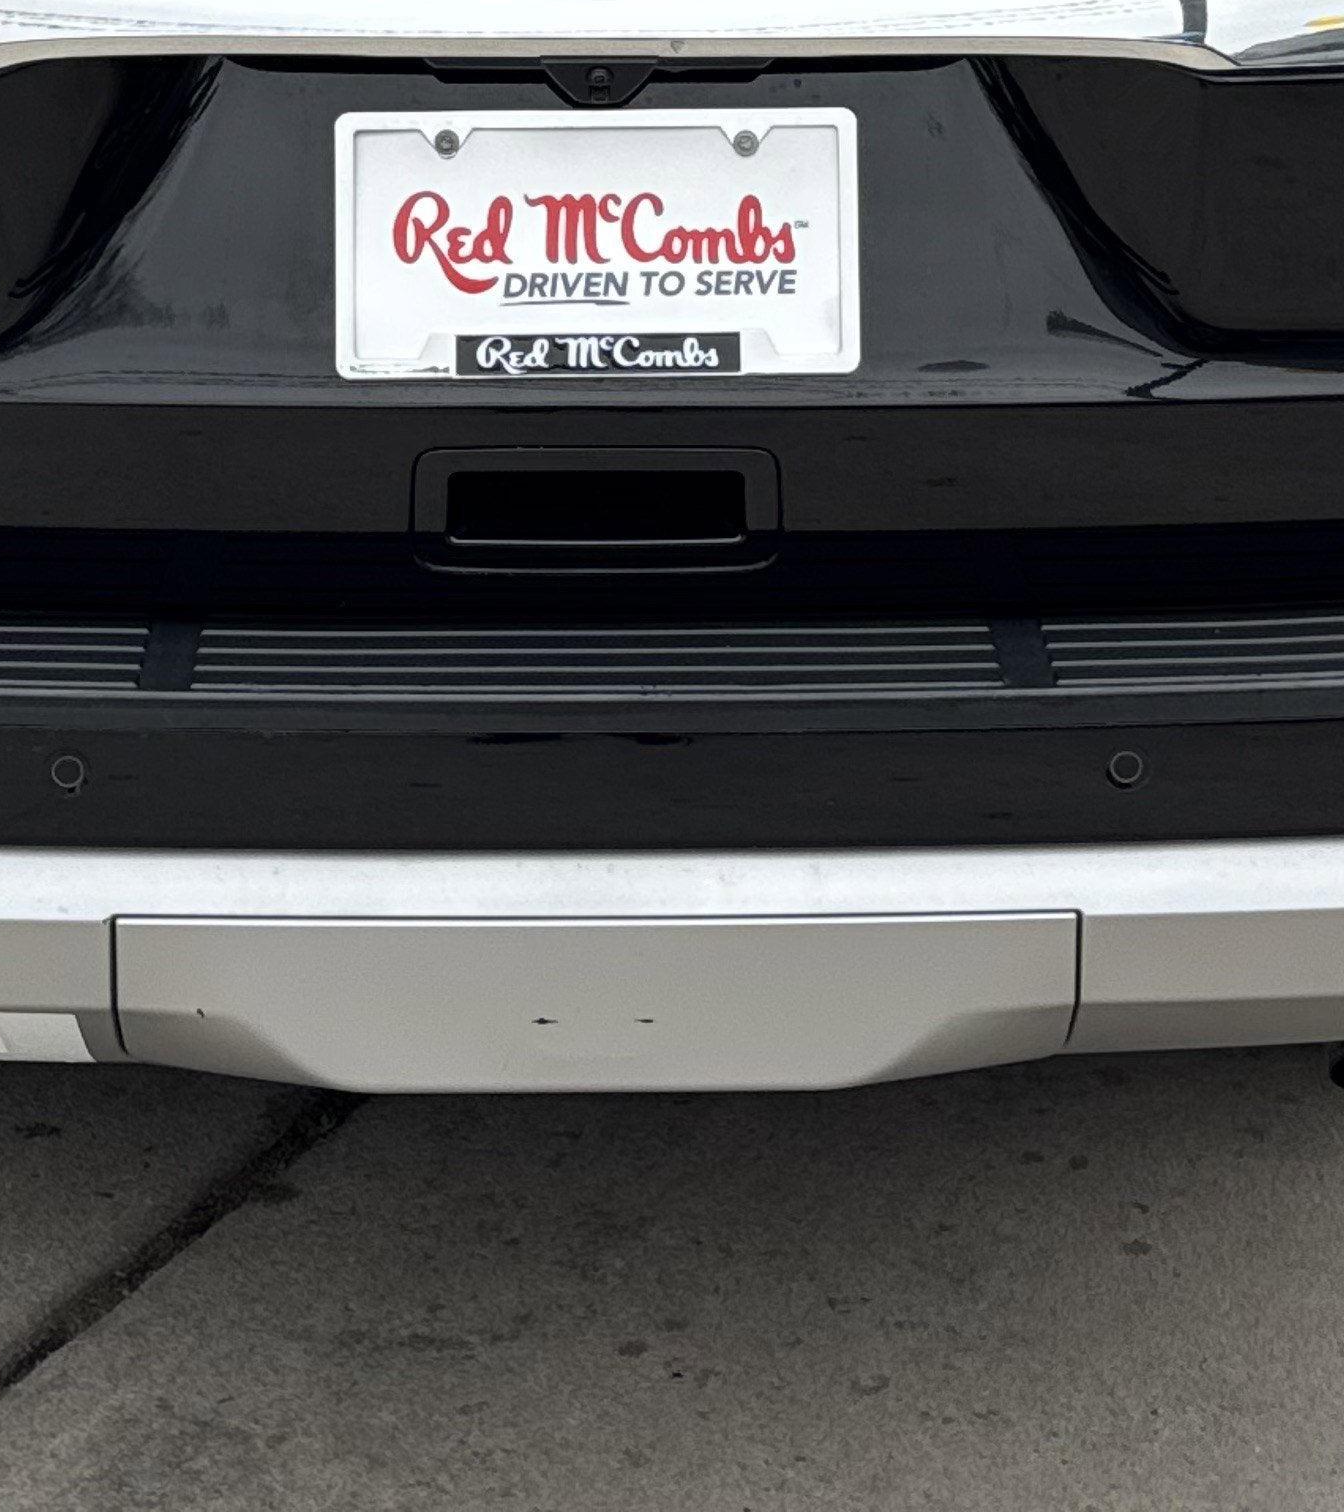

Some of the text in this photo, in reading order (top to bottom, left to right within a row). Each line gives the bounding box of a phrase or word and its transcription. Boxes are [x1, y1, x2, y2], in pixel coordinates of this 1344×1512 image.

[393, 191, 514, 294] Red
[524, 192, 797, 264] McCombs
[503, 269, 798, 299] DRIVEN TO SERVE
[476, 335, 719, 375] Red McCombs
